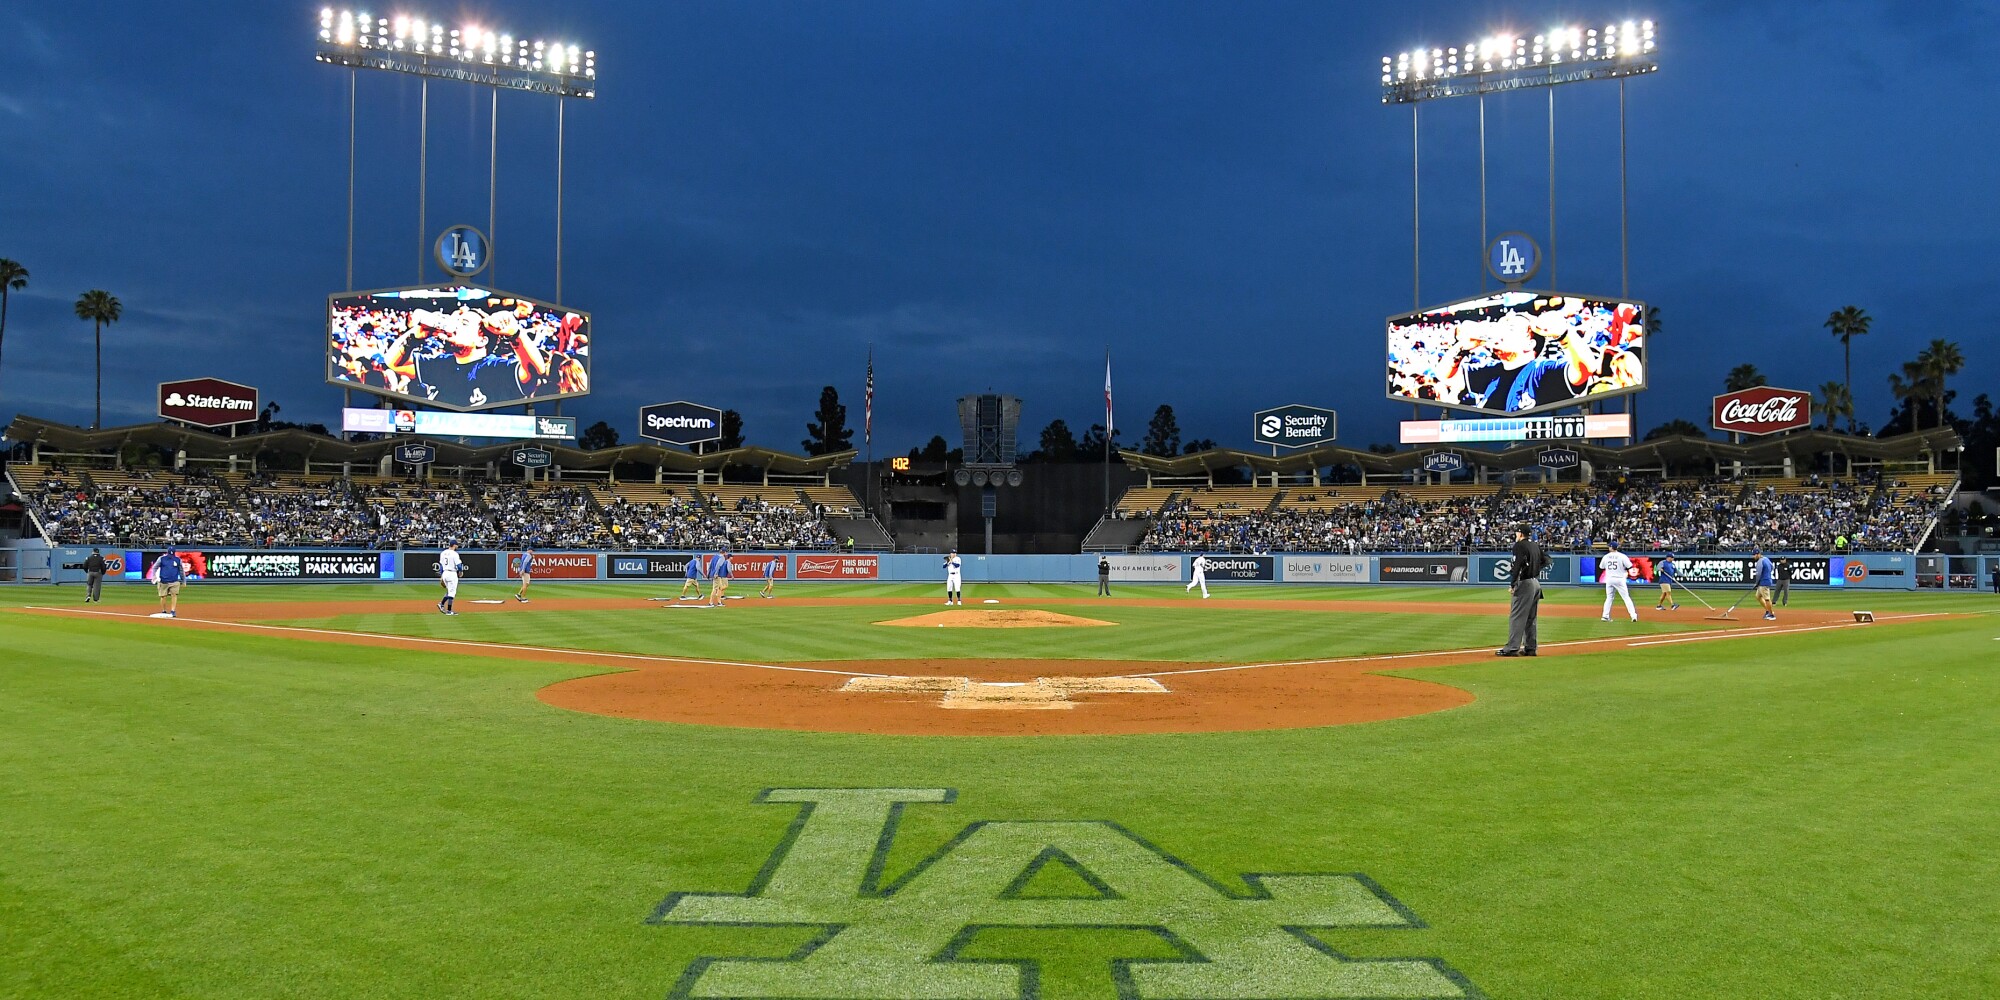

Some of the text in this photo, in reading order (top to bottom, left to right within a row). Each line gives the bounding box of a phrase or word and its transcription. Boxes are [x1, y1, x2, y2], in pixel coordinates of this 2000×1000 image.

[451, 233, 476, 268] LA
[1500, 240, 1525, 274] LA
[1720, 396, 1802, 424] Coca-Cola
[647, 414, 711, 430] Spectrum
[1285, 414, 1328, 427] Security
[1285, 426, 1322, 438] Benefit
[1554, 423, 1562, 437] 0
[1565, 423, 1573, 437] 0
[1576, 422, 1583, 437] 0
[527, 452, 547, 460] Security
[1426, 454, 1459, 468] JIM BEAM
[1541, 453, 1575, 464] DASANI
[892, 457, 909, 469] 1:02
[105, 558, 122, 572] 76
[212, 555, 299, 564] JANET JACKSON
[531, 557, 593, 567] AN MANUEL
[842, 559, 877, 567] THIS BUD'S
[1205, 559, 1256, 572] Spectrum
[1607, 561, 1618, 570] 25
[1693, 560, 1744, 569] JACKSON
[305, 562, 375, 574] PARK MGM
[618, 562, 643, 571] UCLA
[650, 561, 686, 572] Health
[750, 562, 761, 571] FLY
[1288, 562, 1311, 572] blue
[1330, 562, 1353, 572] blue
[1847, 565, 1864, 577] 76
[1791, 568, 1824, 580] MGM
[648, 786, 1488, 1000] LA
